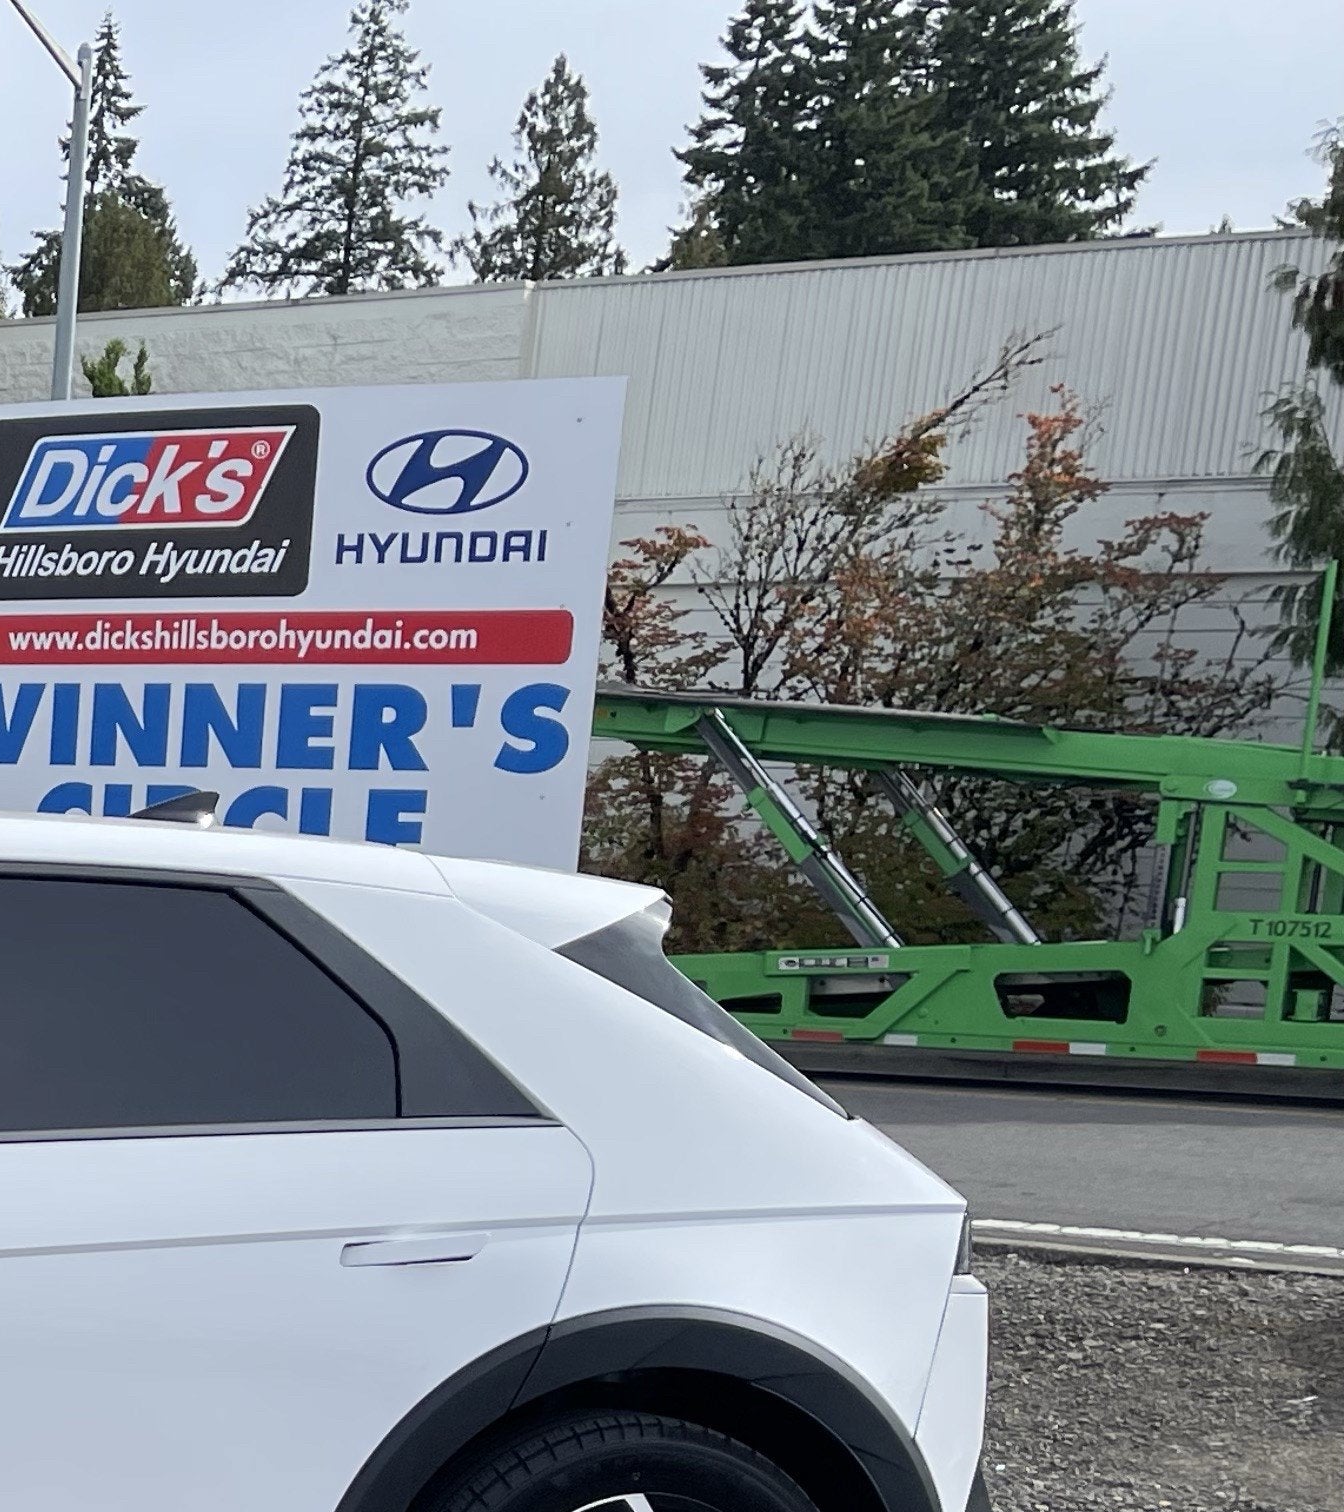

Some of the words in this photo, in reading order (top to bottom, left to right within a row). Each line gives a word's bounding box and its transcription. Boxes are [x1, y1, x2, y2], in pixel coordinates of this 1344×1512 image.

[138, 538, 291, 584] Hyundai
[335, 529, 548, 565] HYUNDAI
[8, 618, 479, 658] www.dickshillsborohyundai.com
[37, 781, 429, 846] CLE
